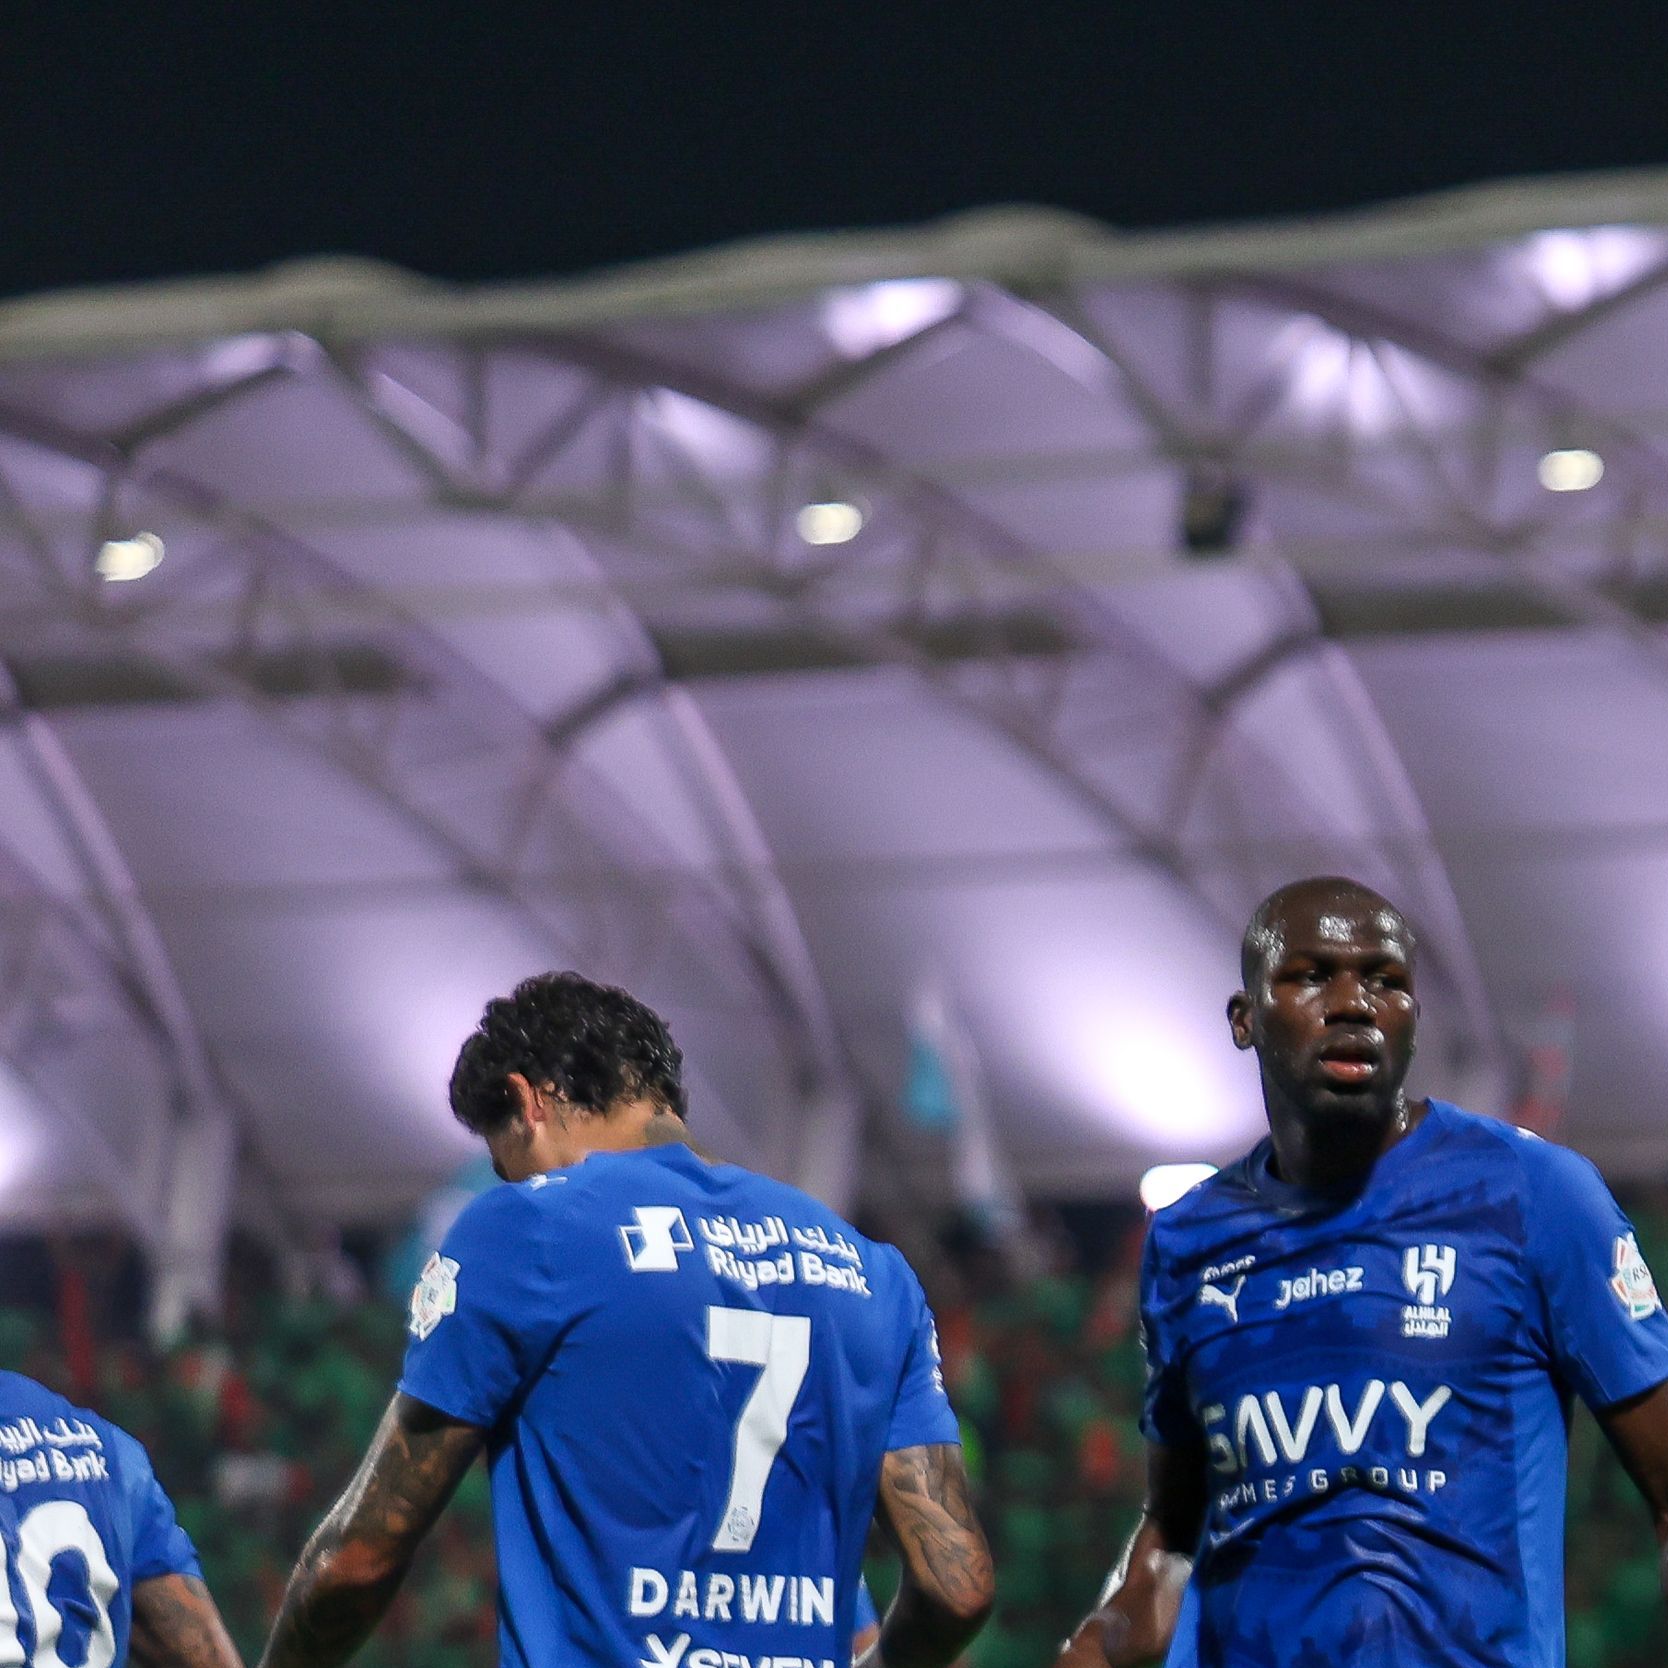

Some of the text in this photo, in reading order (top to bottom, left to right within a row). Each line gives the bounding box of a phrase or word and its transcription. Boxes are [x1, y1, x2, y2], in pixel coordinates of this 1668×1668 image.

[707, 1243, 873, 1299] Riyad Bank
[1403, 1305, 1452, 1323] ALHILAL
[705, 1304, 812, 1553] 7
[0, 1449, 51, 1494] yad
[1310, 1466, 1447, 1495] GROUP
[630, 1567, 834, 1626] DARWIN
